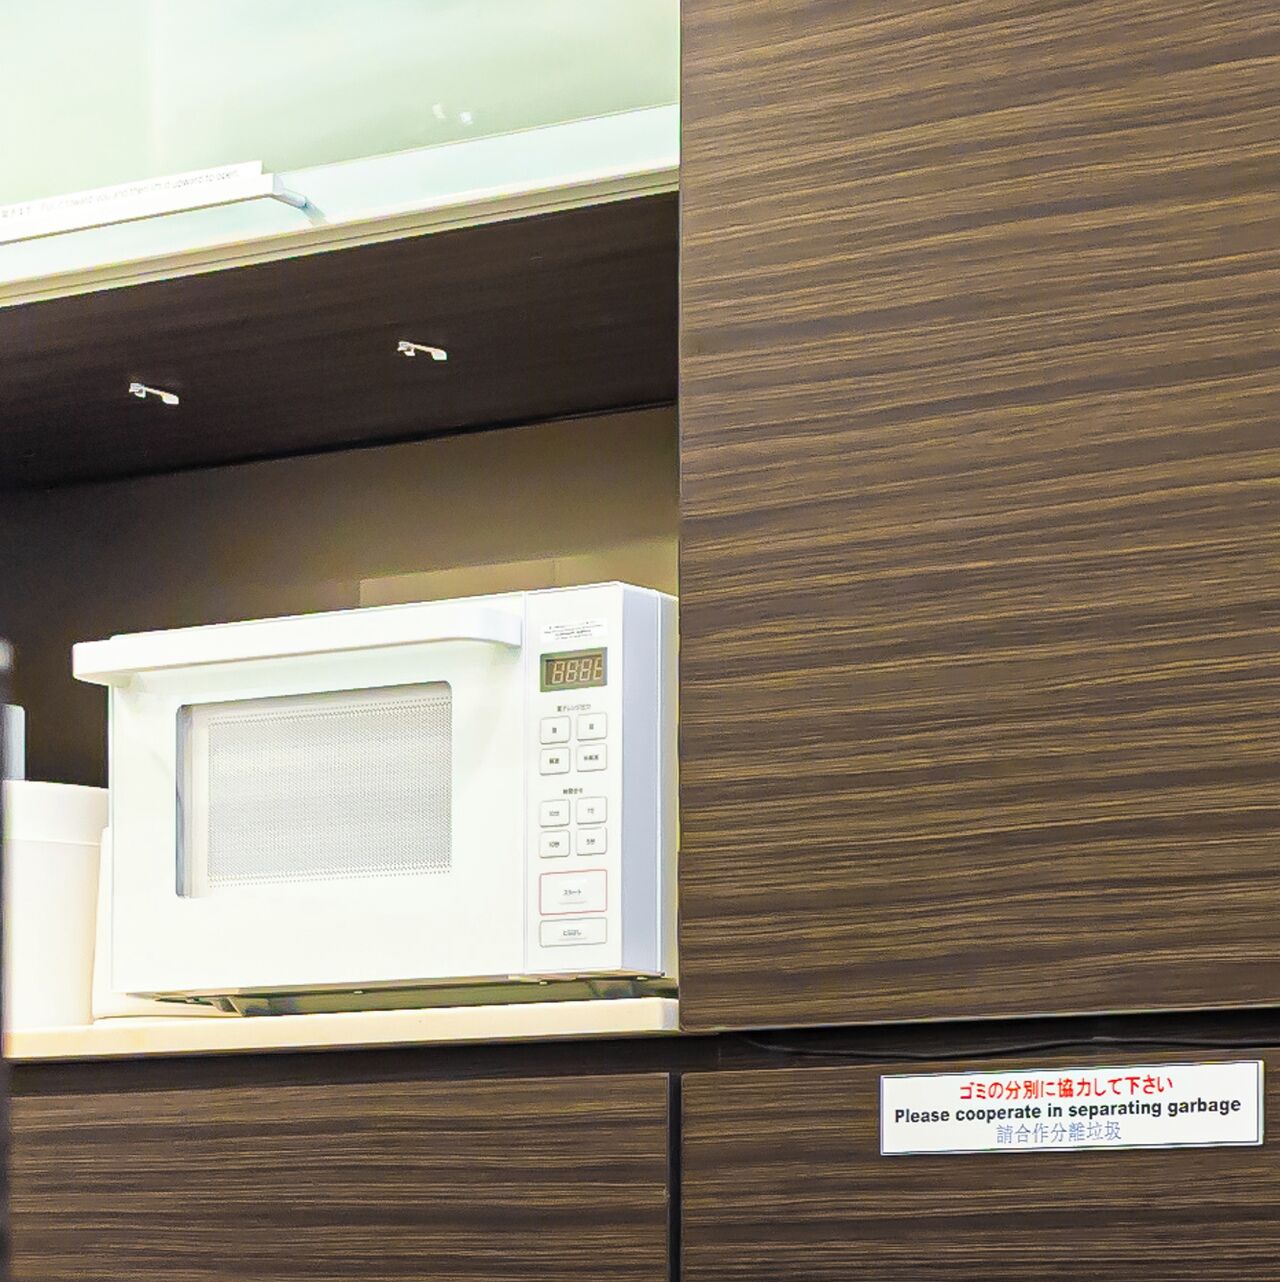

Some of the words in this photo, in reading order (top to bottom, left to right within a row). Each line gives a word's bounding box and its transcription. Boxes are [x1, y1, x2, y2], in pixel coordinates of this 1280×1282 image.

[959, 1074, 1174, 1100] ゴミの分別に協力して下さい
[895, 1108, 950, 1123] Please
[956, 1106, 1041, 1123] cooperate
[1048, 1103, 1062, 1117] in
[1068, 1100, 1162, 1120] separating
[1168, 1098, 1241, 1117] garbage
